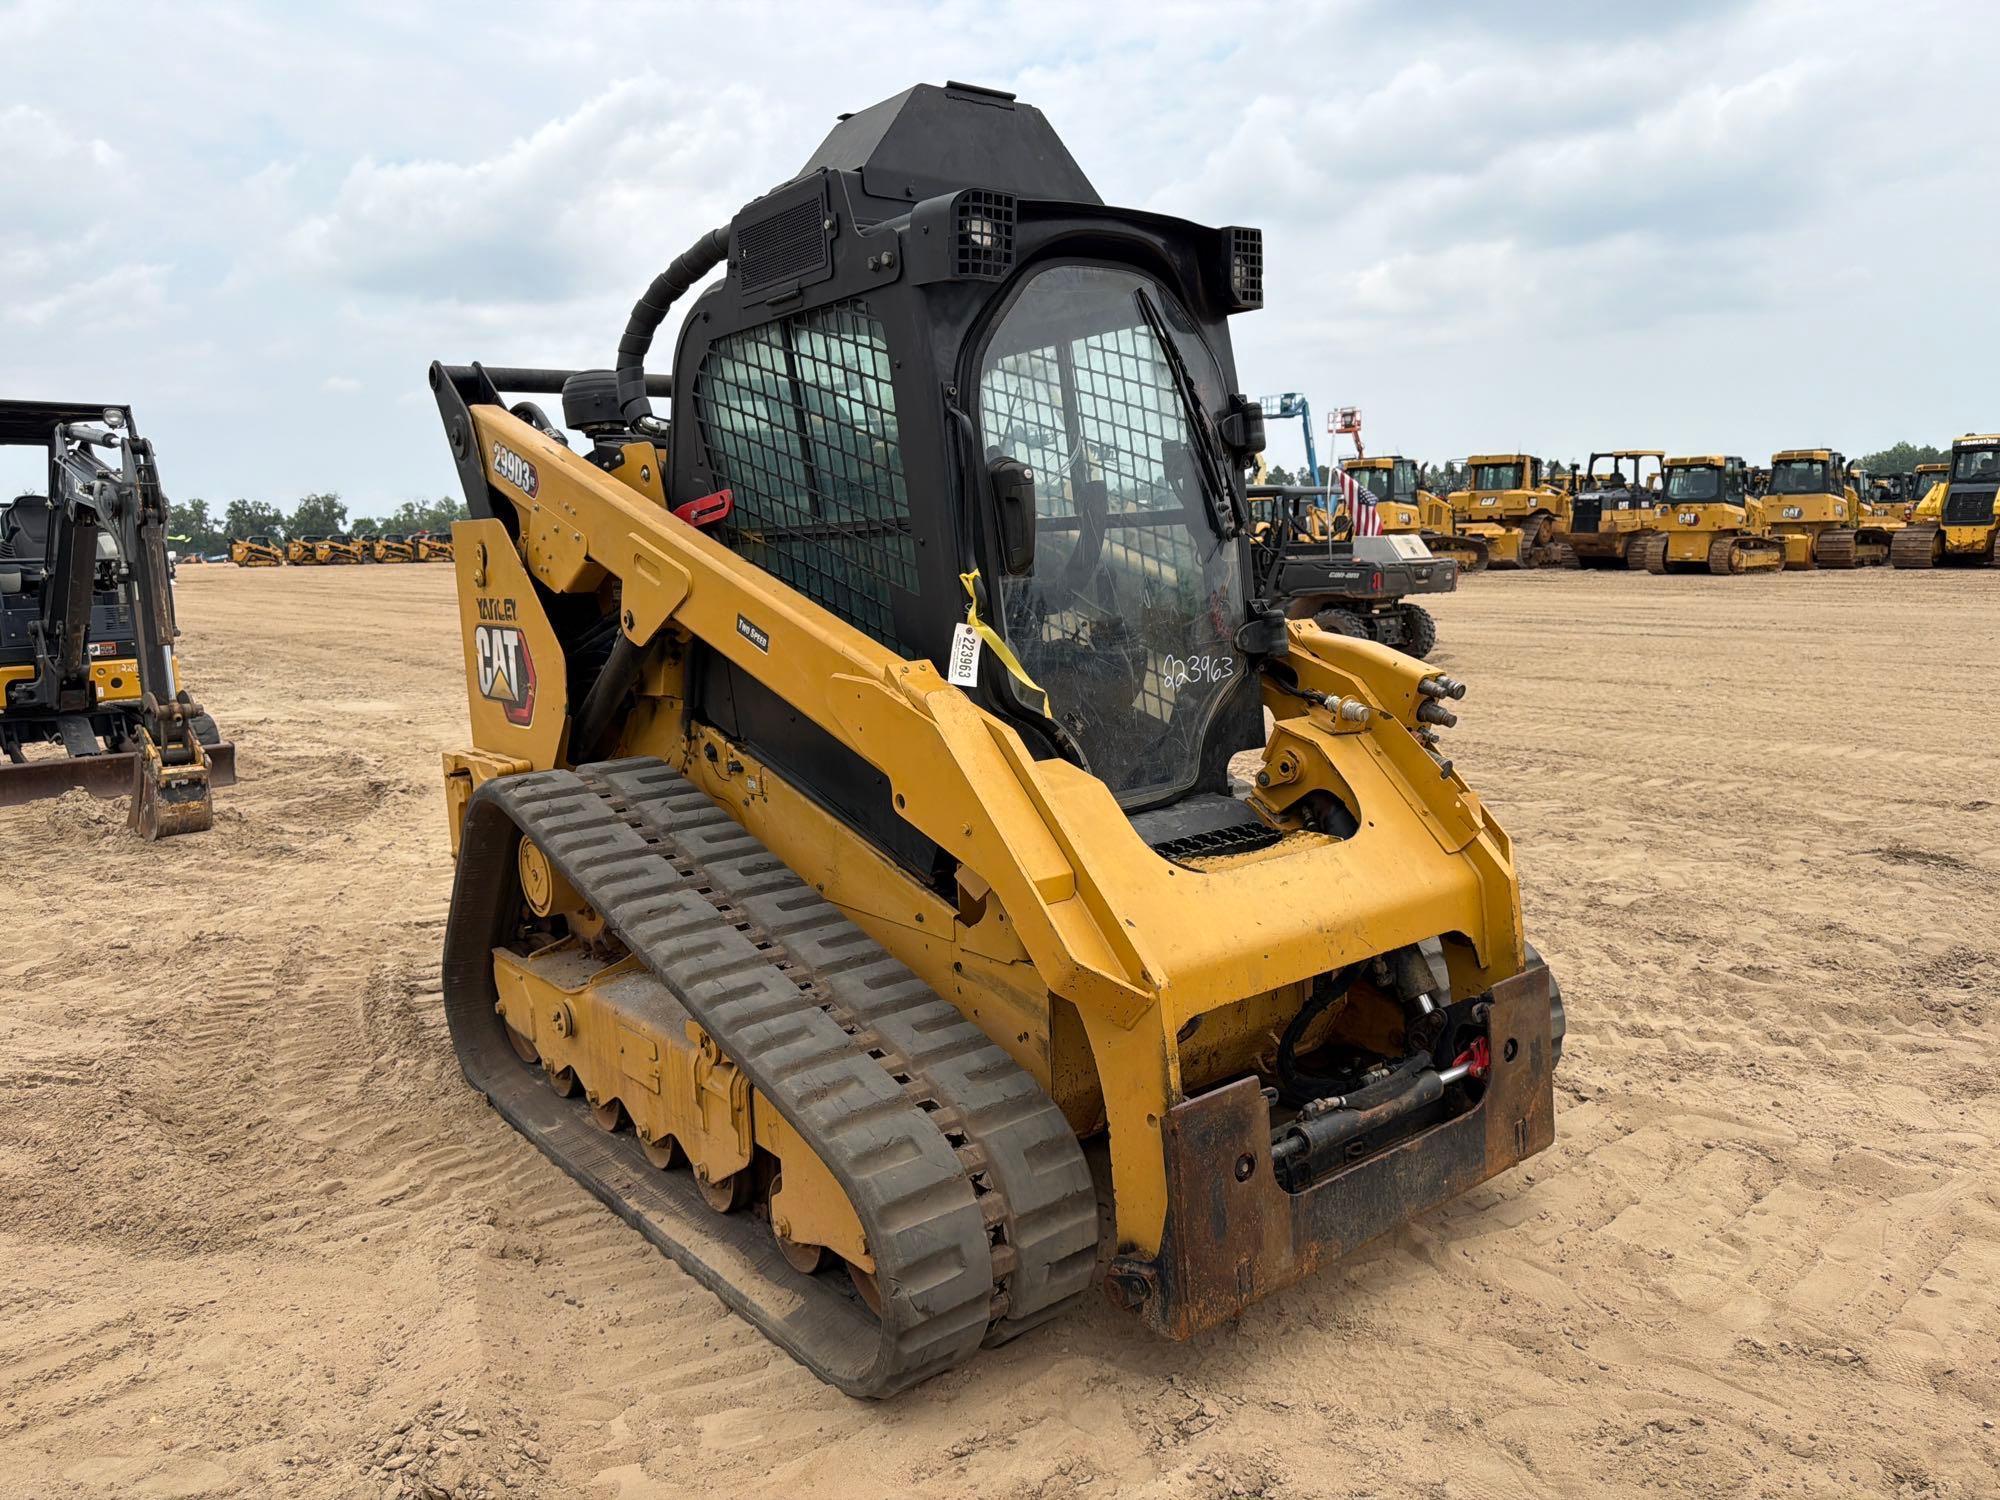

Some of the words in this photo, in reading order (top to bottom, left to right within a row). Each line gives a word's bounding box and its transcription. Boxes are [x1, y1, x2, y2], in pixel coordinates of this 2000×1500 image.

[1961, 438, 1999, 446] KOMATSU
[493, 442, 530, 492] 299D3
[1481, 497, 1497, 506] CAT
[1618, 501, 1630, 510] CAT
[1783, 507, 1800, 518] CAT
[1678, 513, 1696, 525] CAT
[475, 626, 520, 701] CAT
[958, 637, 976, 678] 223963
[1162, 653, 1234, 689] 223963
